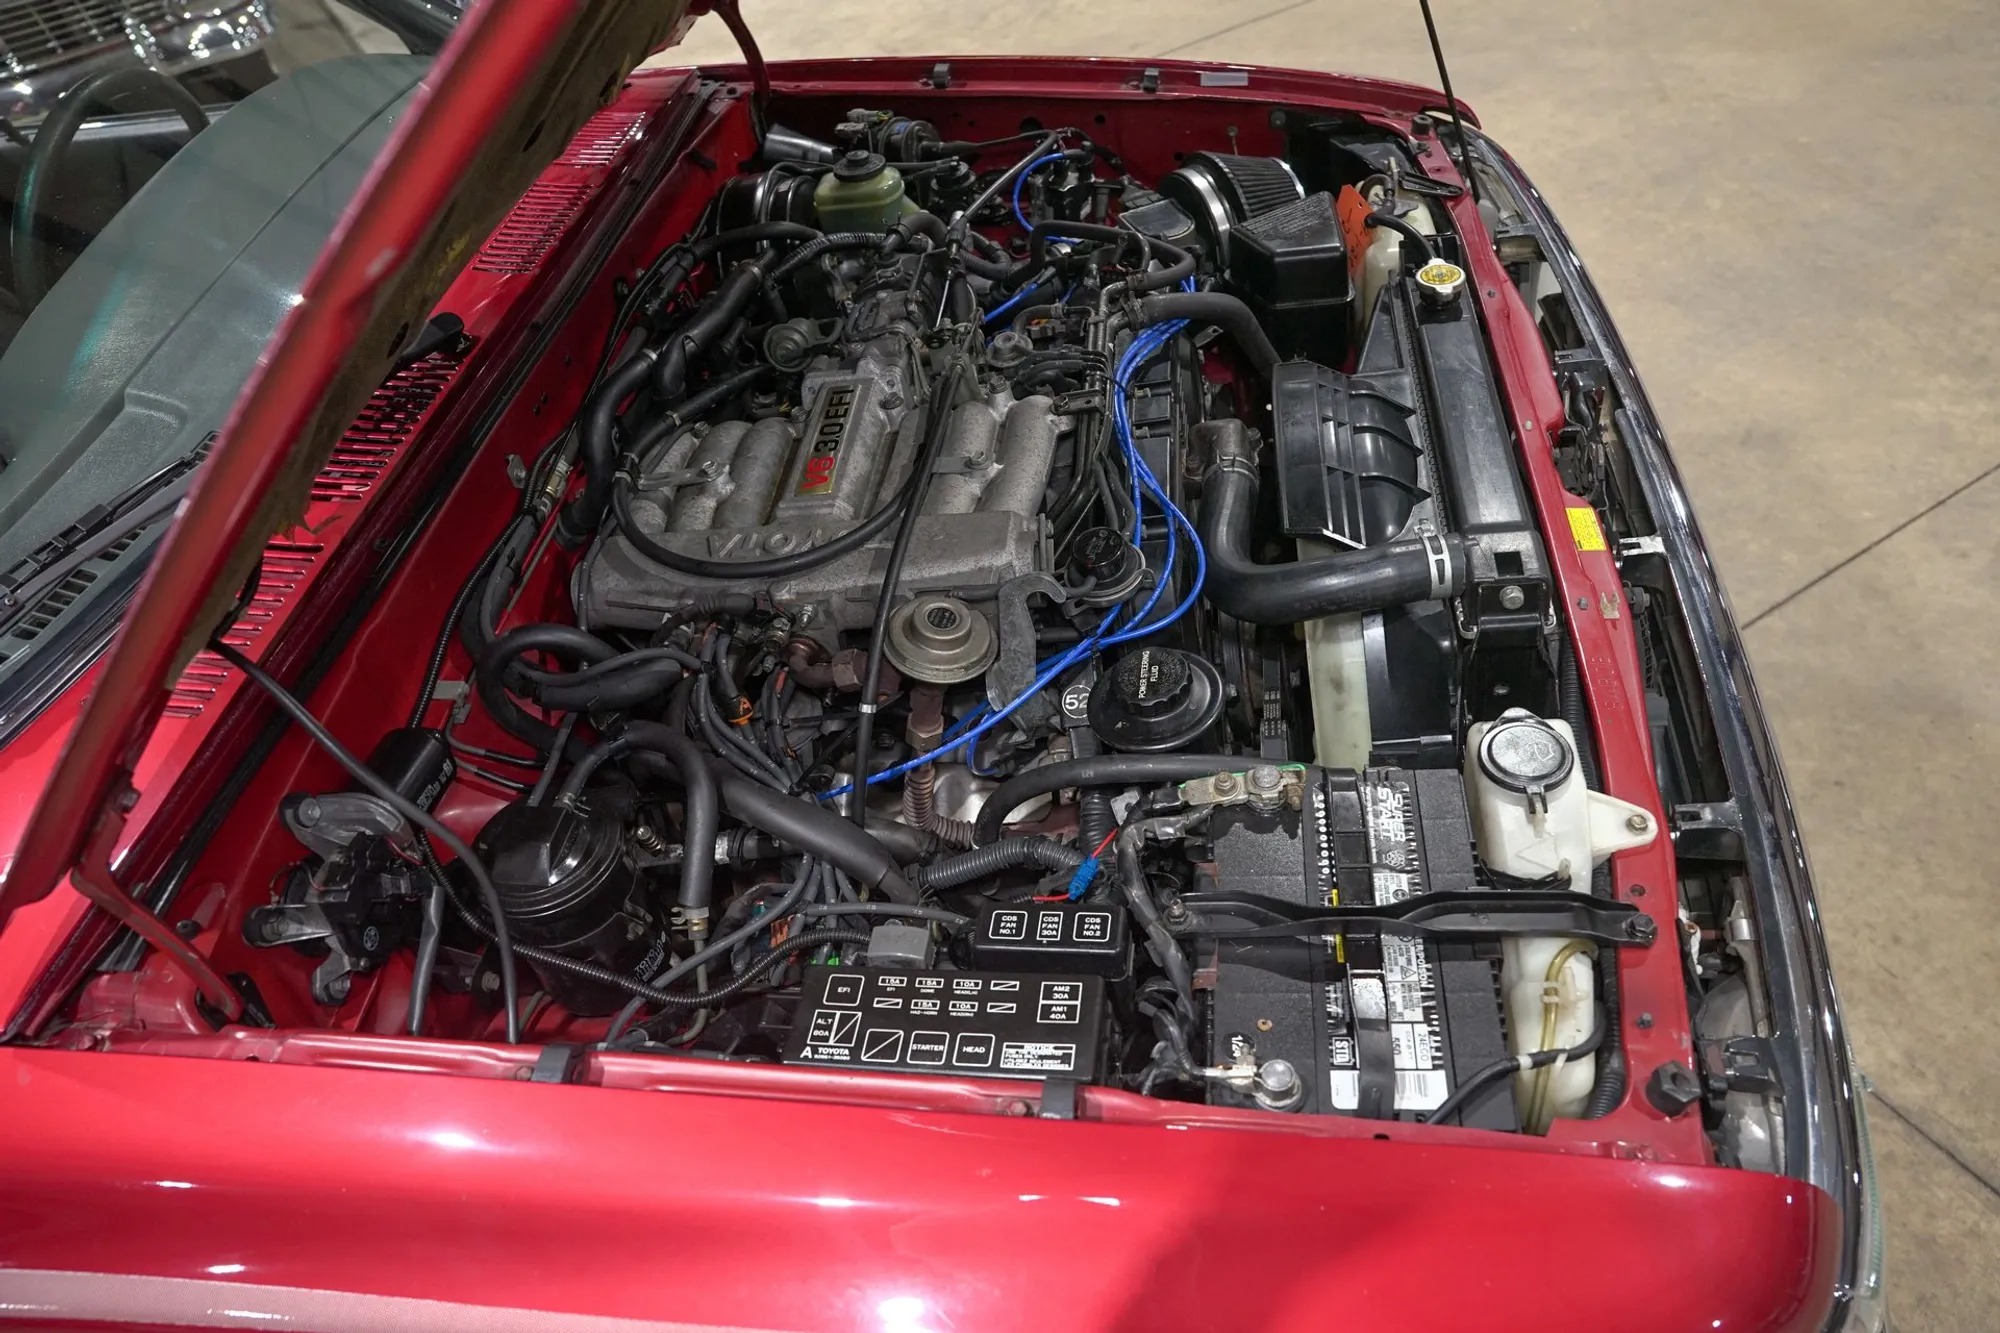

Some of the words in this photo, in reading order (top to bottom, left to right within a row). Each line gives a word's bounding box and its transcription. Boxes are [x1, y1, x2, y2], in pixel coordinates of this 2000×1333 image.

[824, 389, 855, 419] EFI
[814, 423, 844, 452] 3.0
[800, 456, 835, 489] V6
[1141, 650, 1150, 678] STEERING
[1150, 665, 1159, 682] FLUID
[1138, 679, 1147, 698] POWER
[1065, 693, 1089, 710] 52
[1377, 787, 1395, 842] START
[1391, 793, 1406, 842] SUPER
[800, 1046, 812, 1059] A
[817, 1047, 849, 1055] TOYOTA
[911, 1044, 945, 1052] STARTER
[1335, 1040, 1349, 1062] STD
